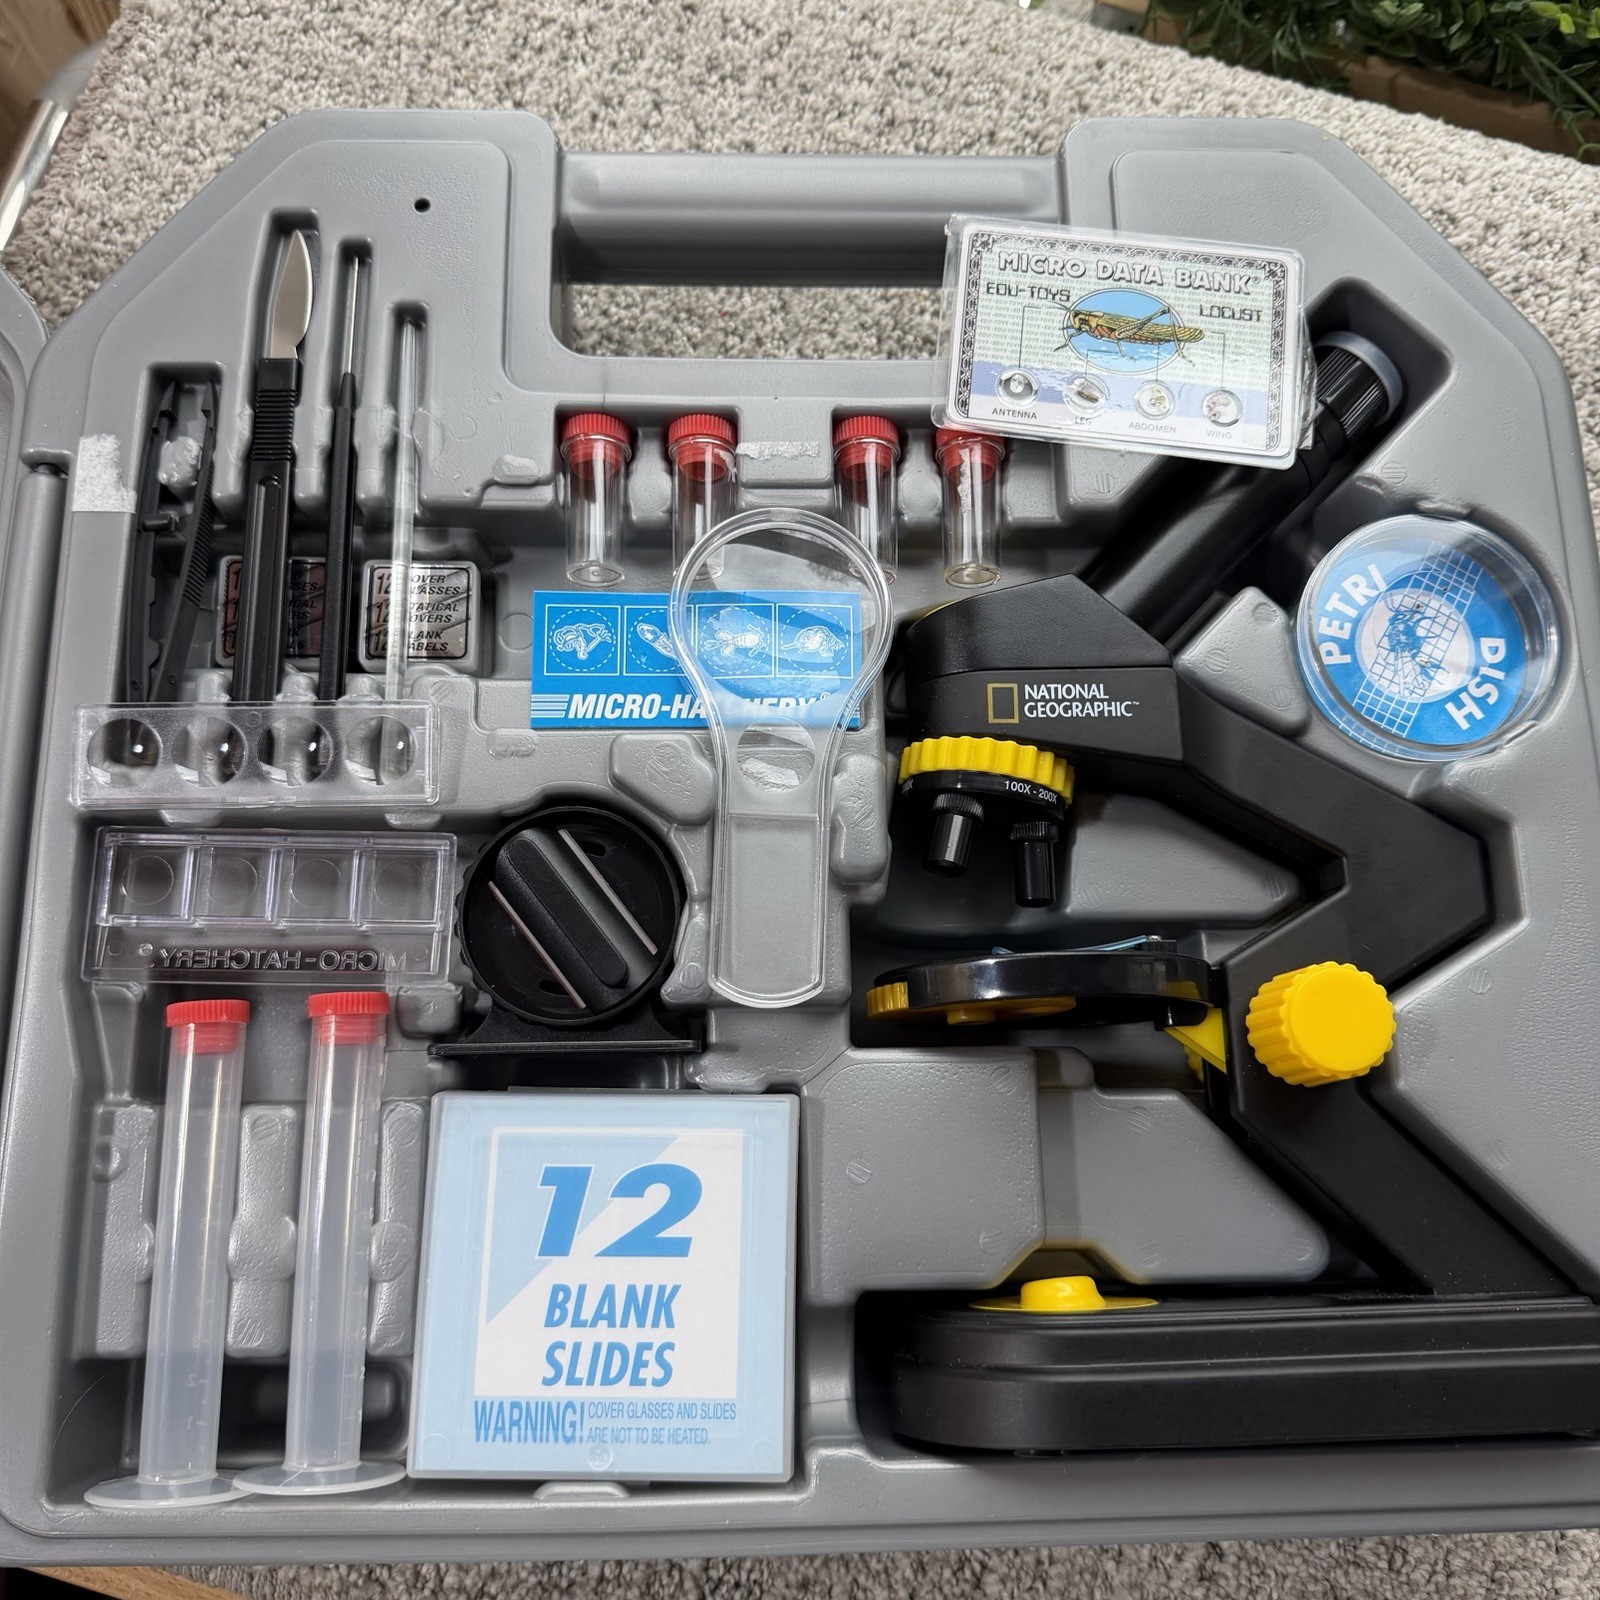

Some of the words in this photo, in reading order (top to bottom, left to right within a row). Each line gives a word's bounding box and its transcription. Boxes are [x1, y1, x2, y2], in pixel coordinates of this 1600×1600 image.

[998, 251, 1087, 279] MICRO
[1097, 260, 1164, 286] DATA
[986, 282, 1071, 302] EDU-TOYS
[1200, 304, 1262, 322] LOCUST
[991, 407, 1037, 420] ANTENNA
[1074, 416, 1092, 426] LEG
[1128, 421, 1177, 433] ABDOMEN
[1206, 429, 1233, 440] WING
[411, 574, 446, 583] OVER
[410, 586, 461, 595] LASSES
[411, 602, 459, 612] TATICAL
[1318, 563, 1387, 665] PETRI
[410, 614, 453, 623] OVERS
[408, 631, 442, 640] LANK
[407, 642, 449, 651] ABELS
[1024, 683, 1109, 700] NATIONAL
[1444, 637, 1507, 731] DISH
[1004, 780, 1031, 795] 100X
[1038, 788, 1058, 804] 200X
[536, 1162, 703, 1259] 12
[544, 1283, 682, 1329] BLANK
[541, 1340, 676, 1388] SLIDES
[588, 1401, 624, 1419] COVER
[627, 1402, 674, 1419] GLASSES
[676, 1402, 698, 1419] AND
[700, 1402, 736, 1420] SLIDES
[473, 1400, 585, 1445] WARNING!
[587, 1426, 609, 1444] ARE
[611, 1427, 633, 1444] NOT
[634, 1427, 649, 1444] TO
[651, 1427, 665, 1444] BE
[668, 1427, 711, 1445] HEATED.
